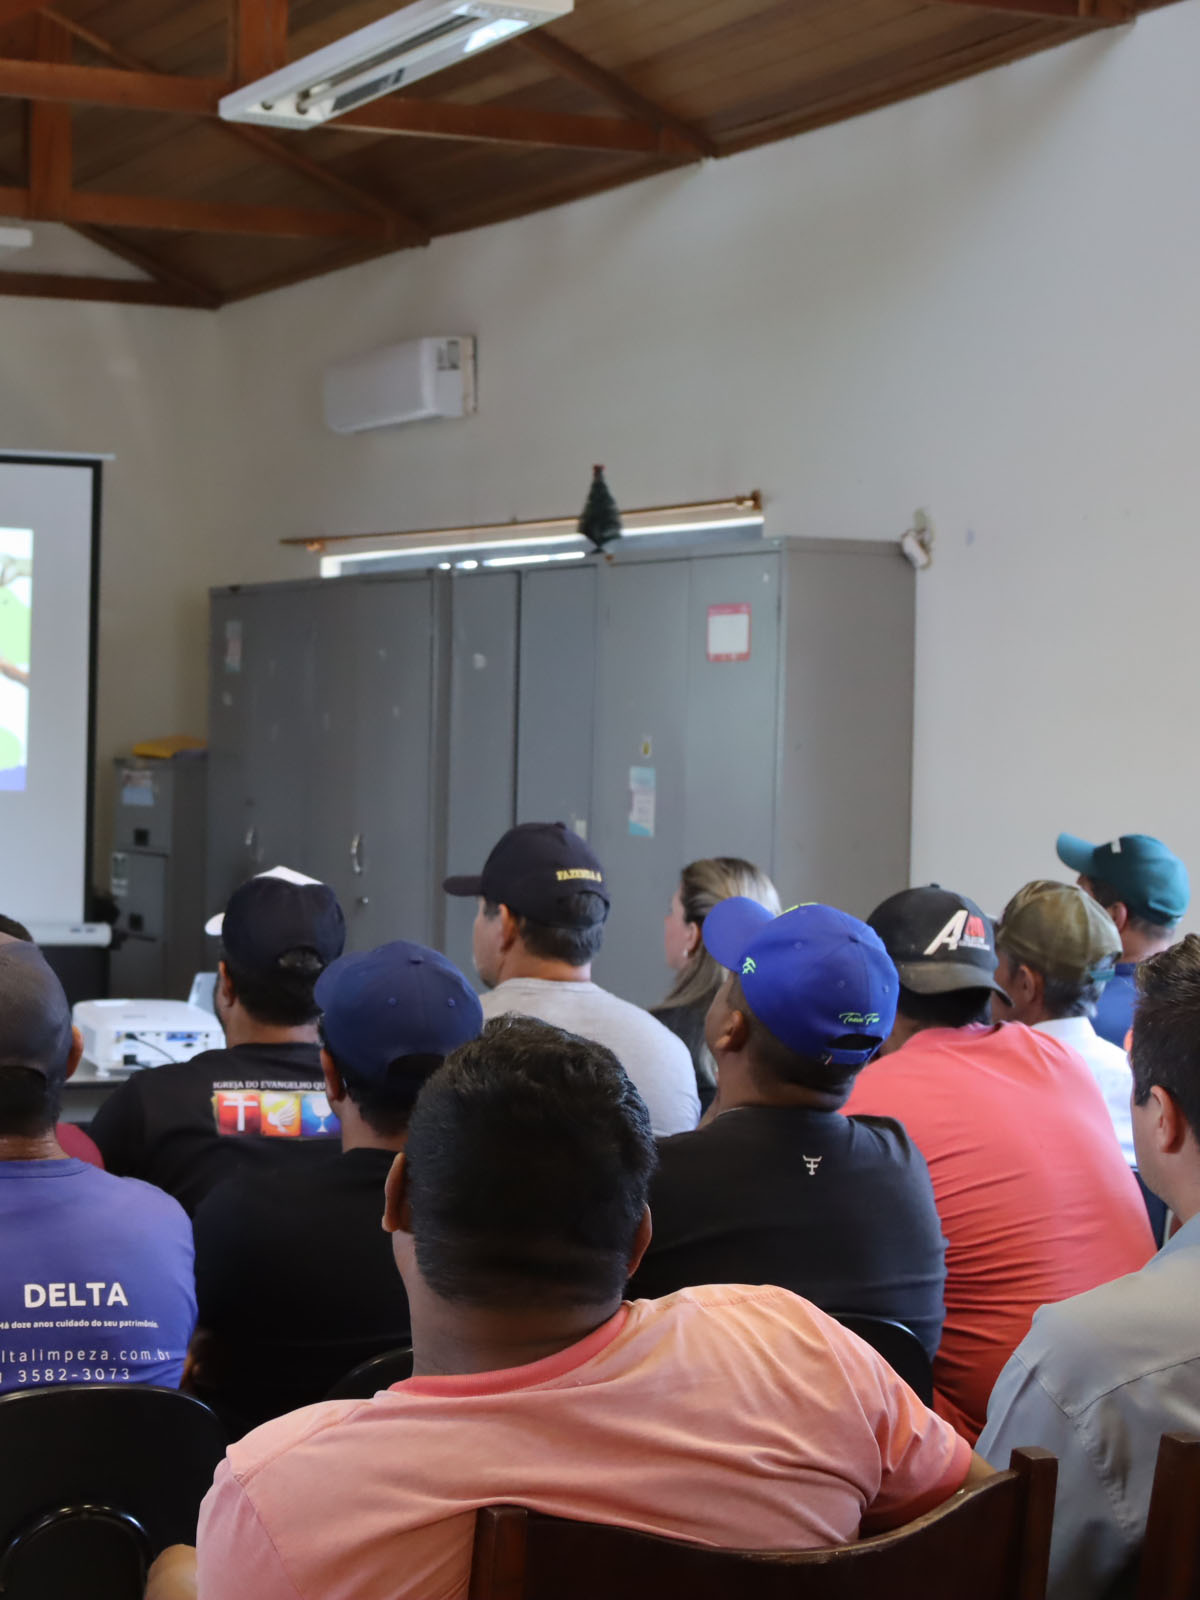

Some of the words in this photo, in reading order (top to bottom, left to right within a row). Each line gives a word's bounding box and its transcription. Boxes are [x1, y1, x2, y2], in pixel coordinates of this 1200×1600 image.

[213, 1080, 244, 1090] IGREJA
[245, 1080, 259, 1089] DO
[260, 1080, 312, 1090] EVANGELHO
[23, 1282, 129, 1308] DELTA
[11, 1320, 32, 1329] doze
[55, 1319, 90, 1328] cuidado
[91, 1319, 102, 1327] do
[17, 1368, 130, 1383] 3582-3073
